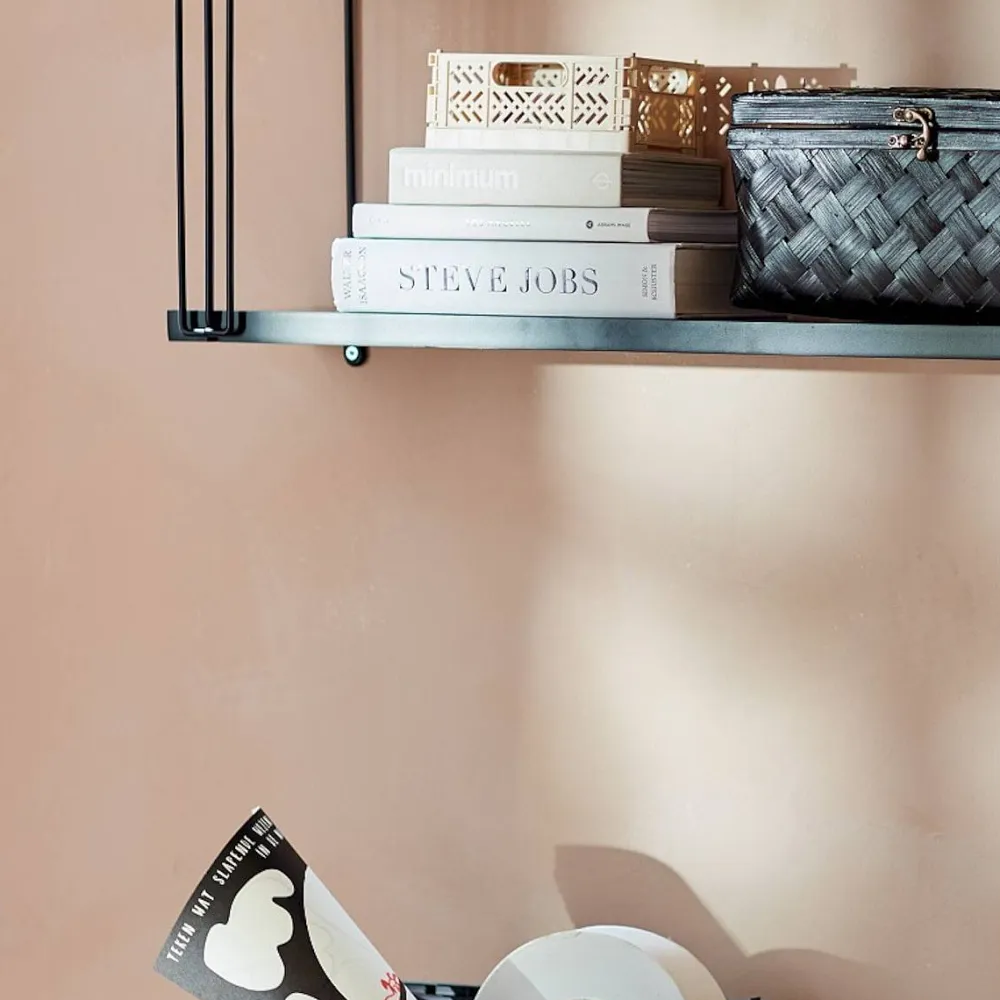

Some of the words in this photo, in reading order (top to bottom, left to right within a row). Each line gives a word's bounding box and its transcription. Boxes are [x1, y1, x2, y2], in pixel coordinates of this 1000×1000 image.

[403, 163, 519, 189] minimum
[343, 249, 352, 300] WALR
[357, 246, 368, 304] ISAACON
[398, 265, 508, 292] STEVE
[519, 266, 599, 295] JOBS
[167, 922, 196, 963] TEKEN
[191, 889, 215, 917] WAT
[212, 834, 257, 886] SLAPENDE
